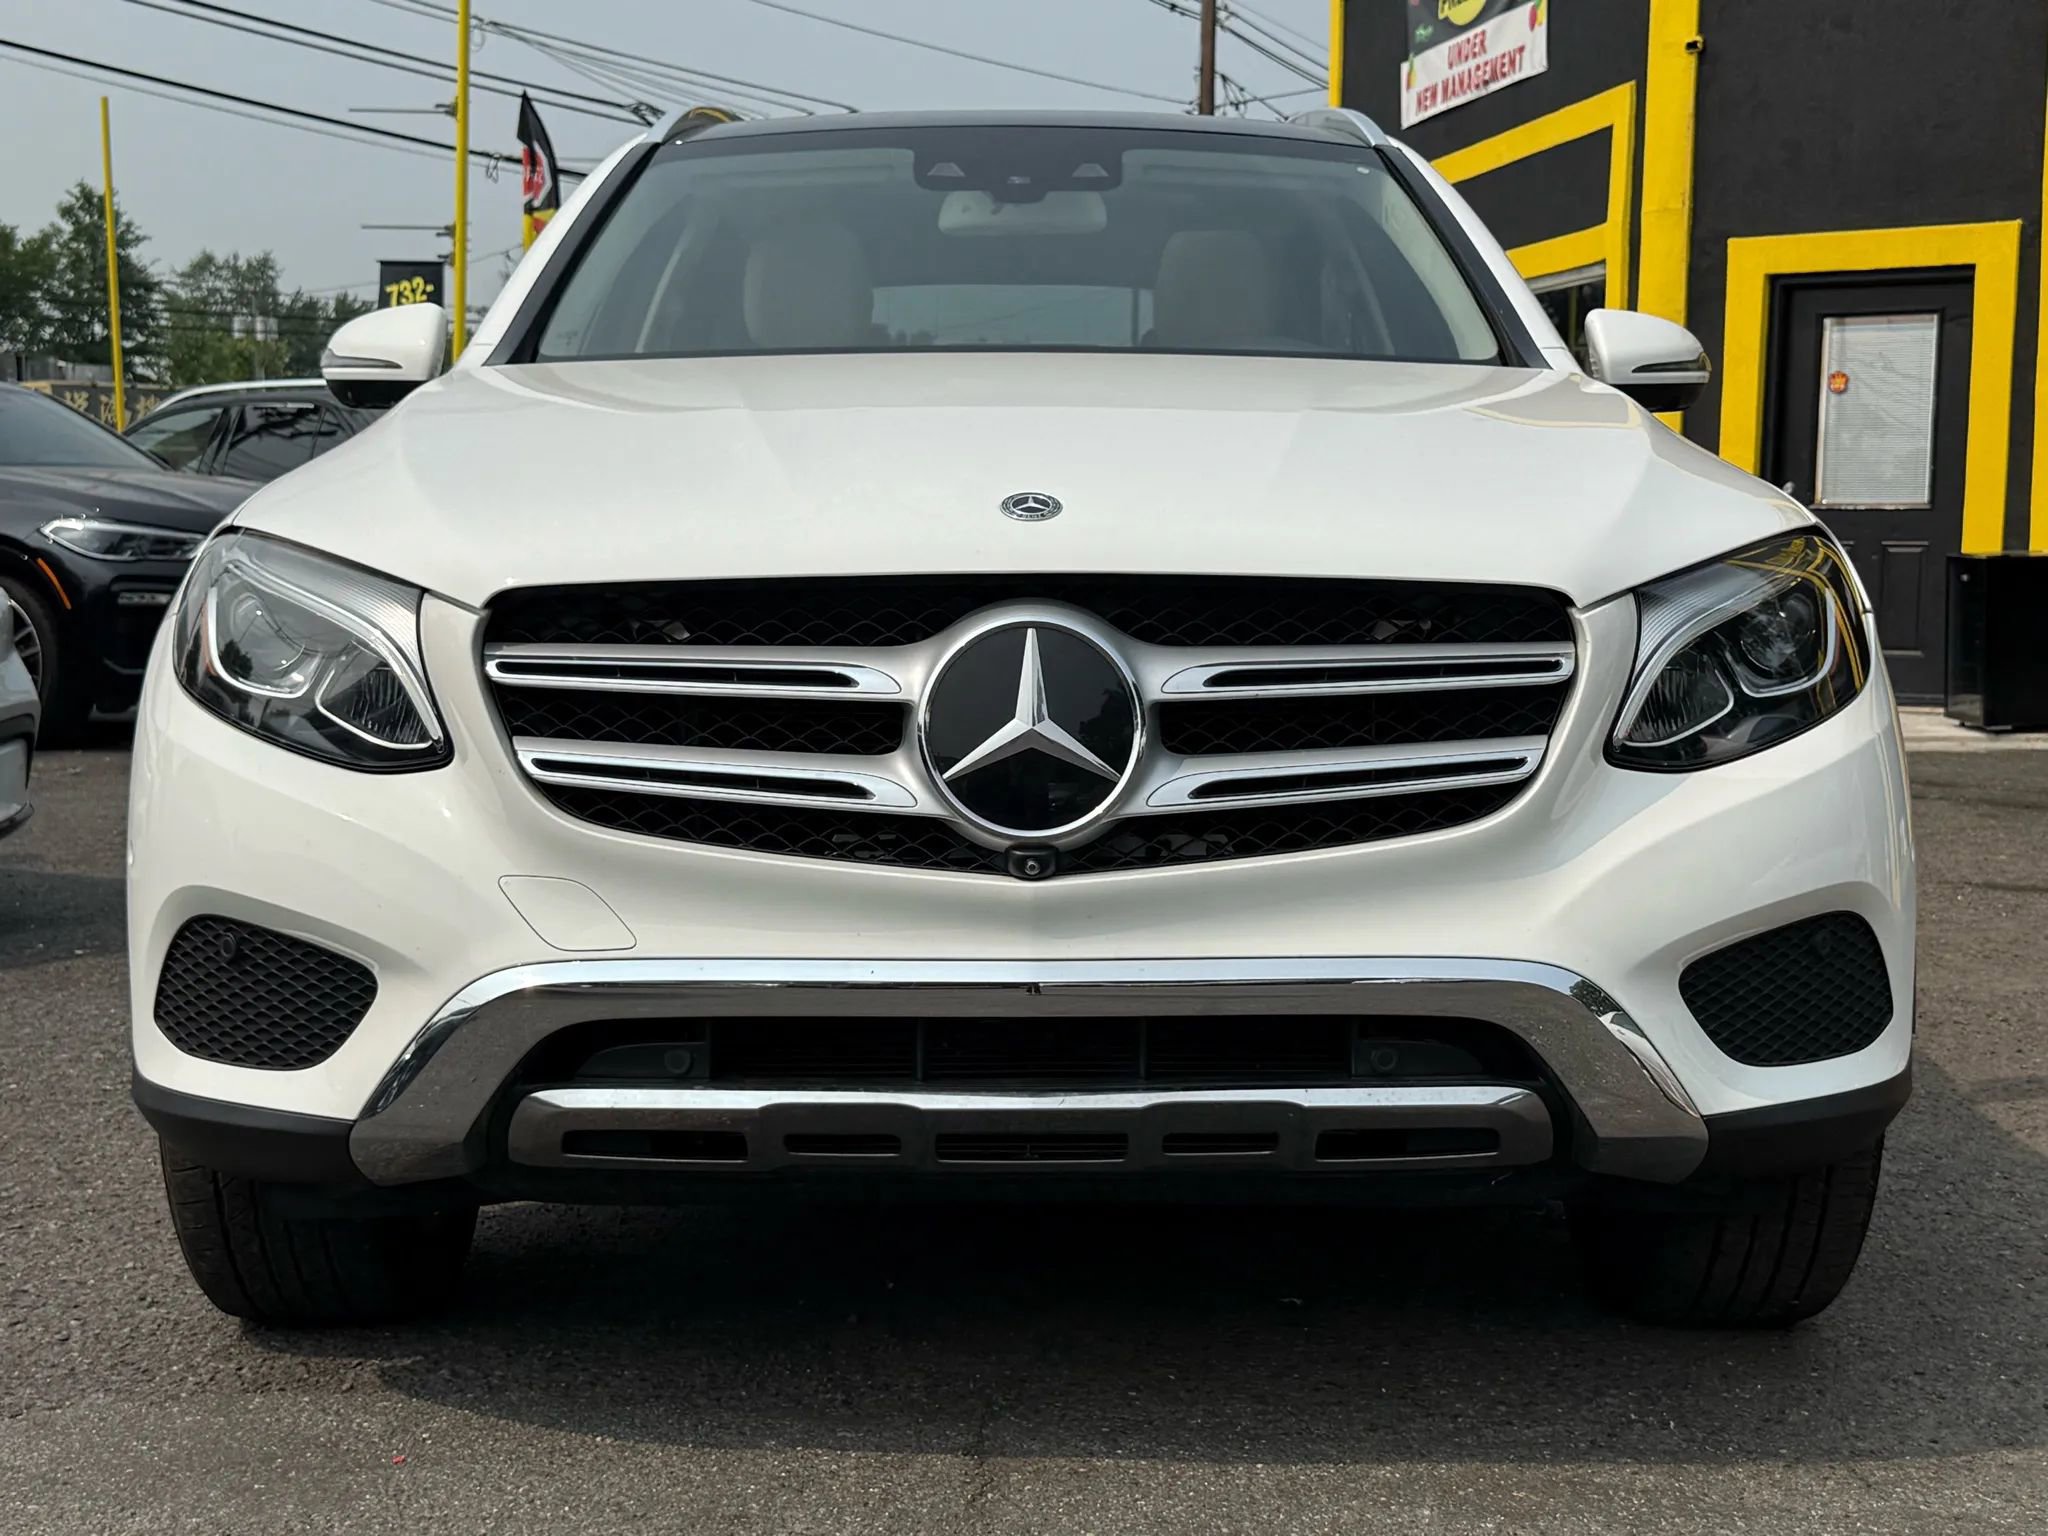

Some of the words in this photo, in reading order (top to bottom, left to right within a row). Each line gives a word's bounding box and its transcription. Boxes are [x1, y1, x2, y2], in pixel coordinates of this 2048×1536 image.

[1447, 29, 1487, 70] UNDER
[1416, 81, 1437, 115] NEW
[1441, 44, 1525, 103] MANAGEMENT
